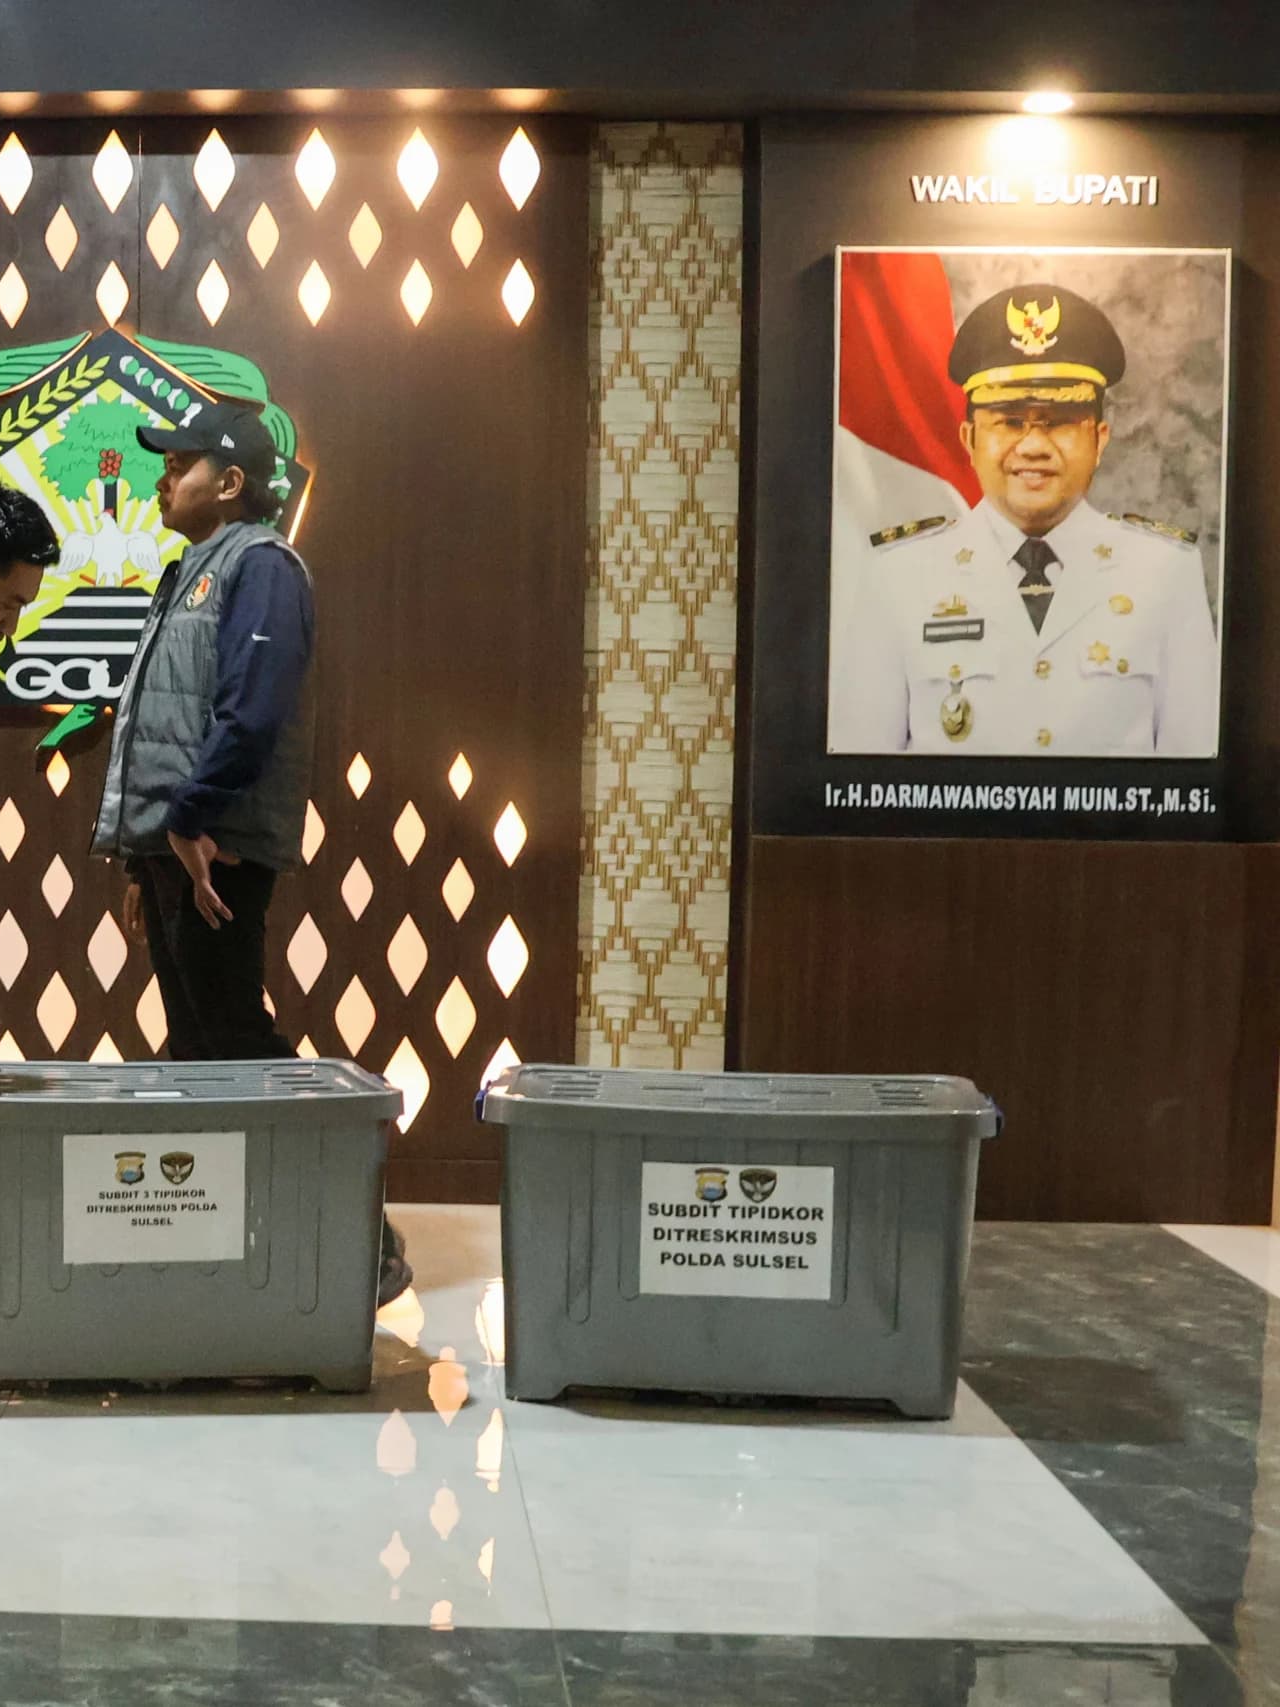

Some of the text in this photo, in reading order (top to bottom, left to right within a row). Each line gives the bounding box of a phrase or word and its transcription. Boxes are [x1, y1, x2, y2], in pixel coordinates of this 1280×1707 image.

[910, 174, 1159, 206] WAKIL BUPATI
[98, 1190, 140, 1200] SUBDIT
[153, 1188, 206, 1199] TIPIDKOR
[86, 1202, 218, 1214] DITRESKRIMSUS POLDA
[648, 1202, 825, 1221] SUBDIT TIPIDKOR
[131, 1217, 174, 1226] SULSEL
[653, 1227, 818, 1245] DITRESKRIMSUS
[660, 1252, 809, 1270] POLDA SULSEL
